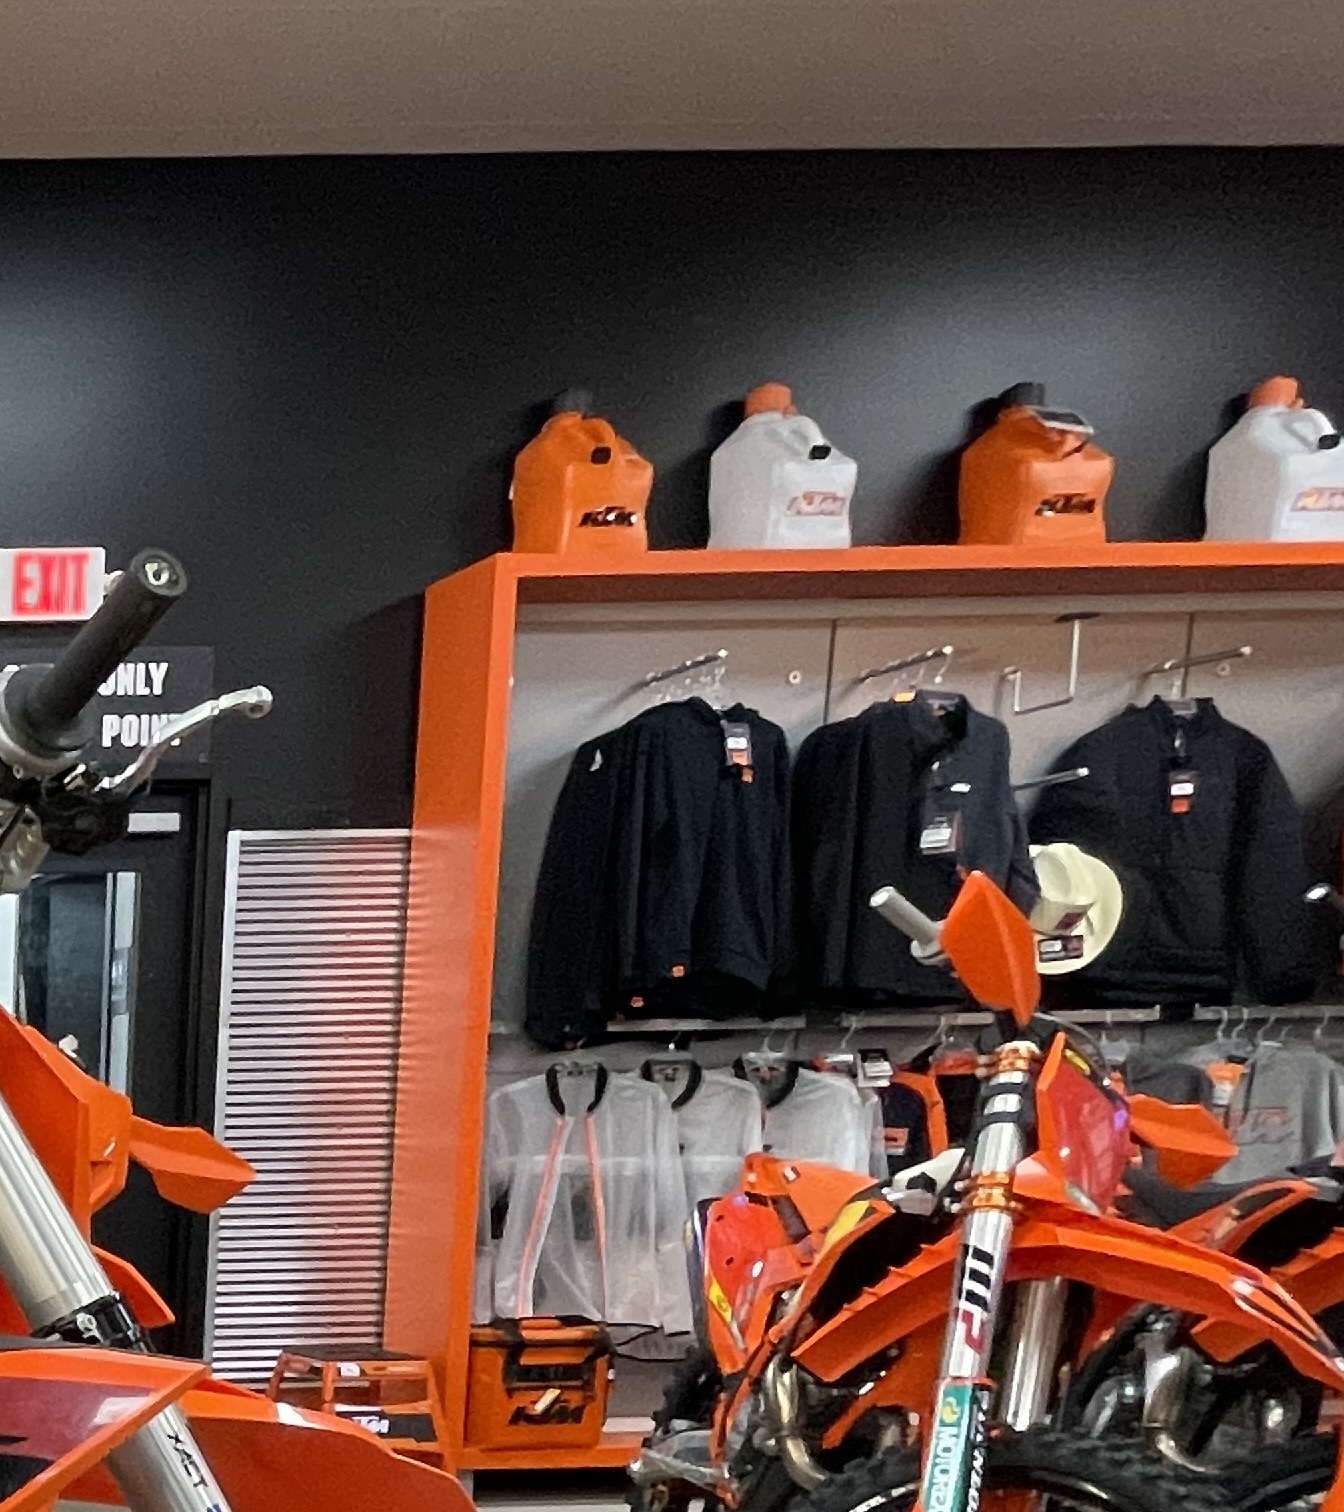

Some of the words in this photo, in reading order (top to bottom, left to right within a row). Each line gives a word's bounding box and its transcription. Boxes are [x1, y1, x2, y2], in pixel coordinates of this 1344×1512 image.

[578, 506, 637, 528] KTM
[1034, 492, 1096, 516] KTM
[14, 553, 90, 616] EXIT
[167, 1434, 209, 1488] XACT
